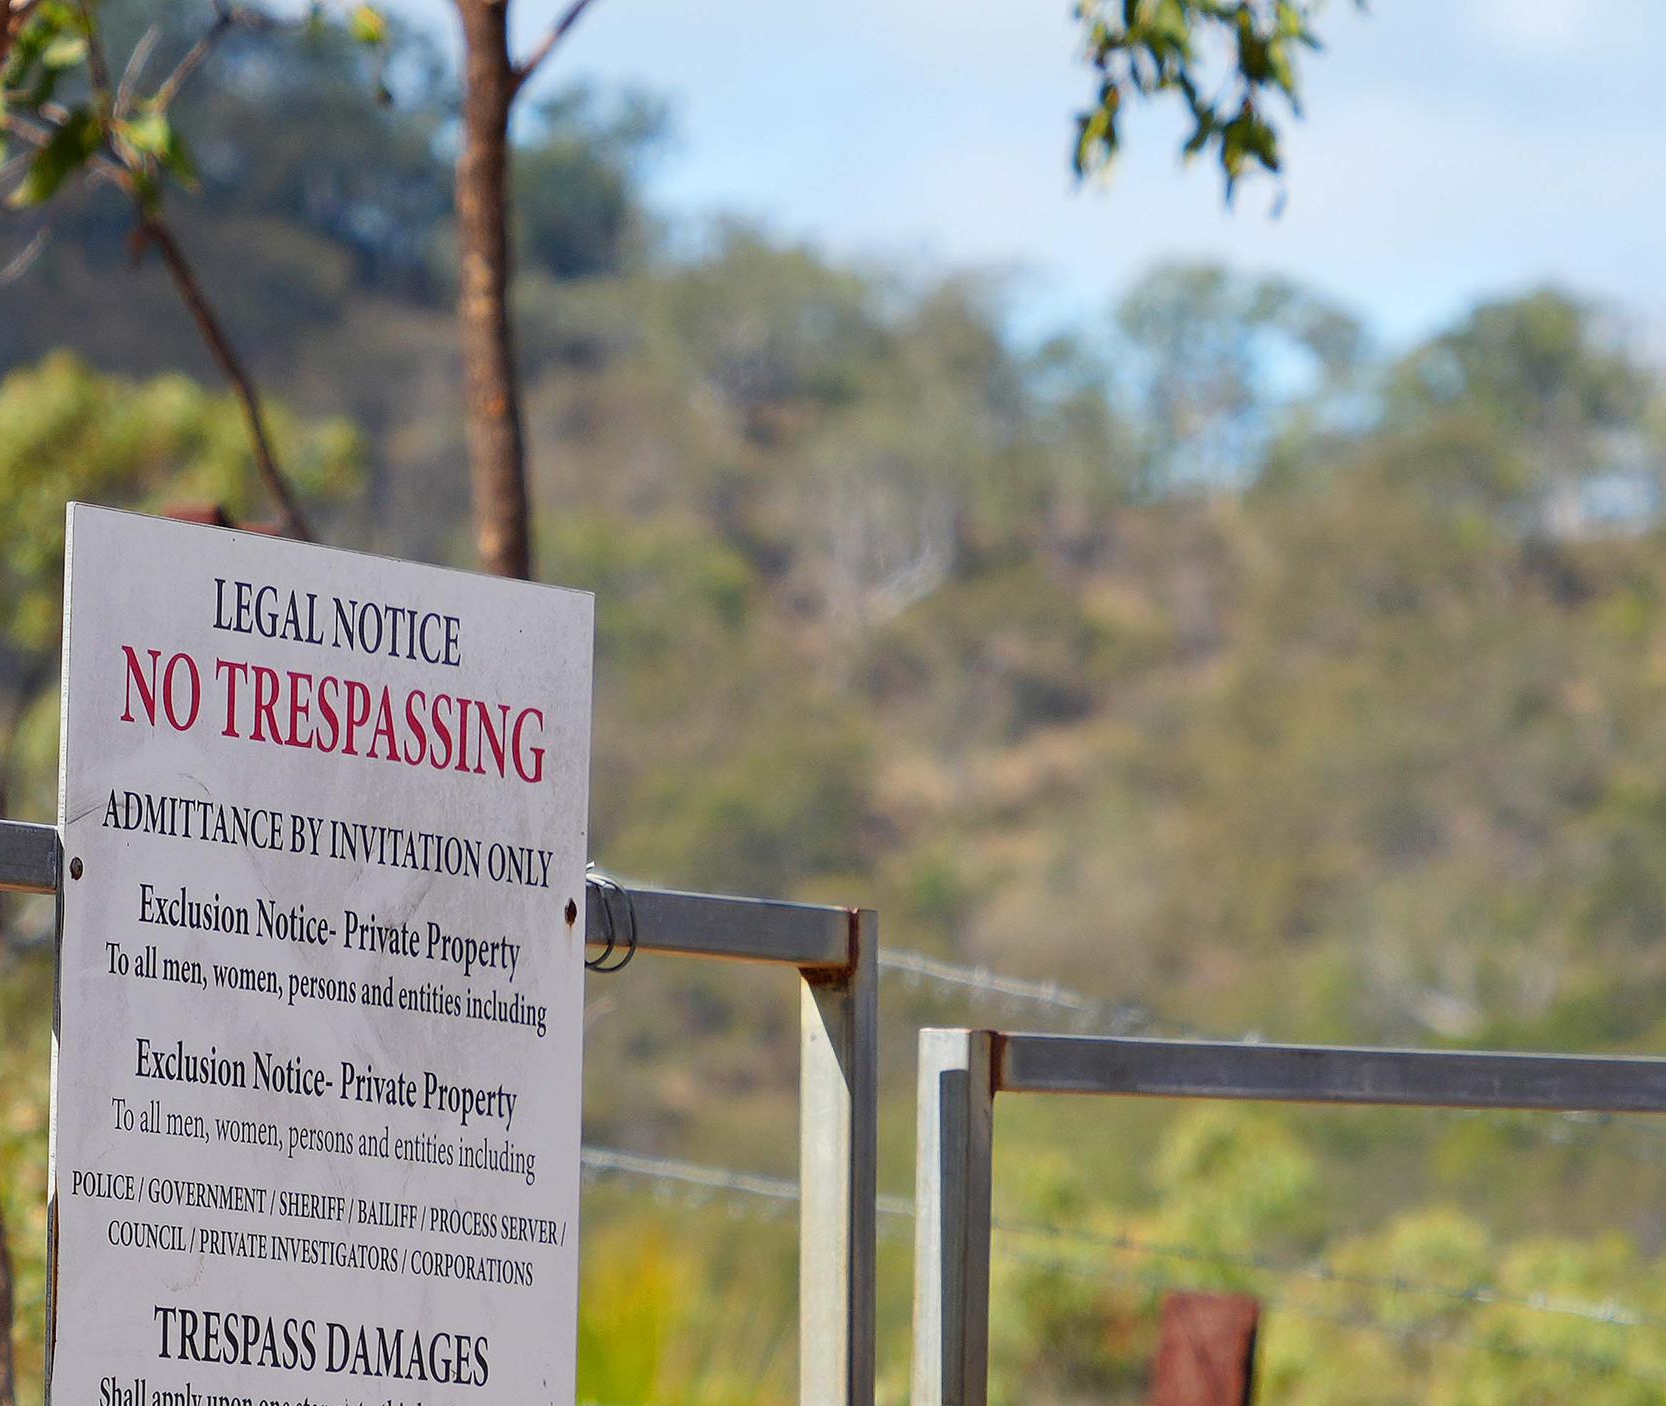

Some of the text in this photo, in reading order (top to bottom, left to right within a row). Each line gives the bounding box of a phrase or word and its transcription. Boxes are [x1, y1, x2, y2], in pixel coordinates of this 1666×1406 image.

[212, 577, 462, 668] LEGAL NOTICE
[120, 644, 546, 784] NO TRESPASSING
[101, 788, 554, 889] ADMITTANCE BY INVITATION ONLY
[138, 883, 521, 984] Exclusion Notice- Private Property
[105, 941, 548, 1038] To all men, women, persons and entities including
[134, 1037, 518, 1132] Exclusion Notice- Private Property
[111, 1097, 536, 1186] To all men, women, persons and entities including
[107, 1220, 187, 1252] COUNCIL
[198, 1228, 268, 1260] PRIVATE
[270, 1235, 399, 1273] INVESTIGATORS
[410, 1249, 533, 1287] CORPORATIONS
[153, 1304, 489, 1387] TRESPASS DAMAGES
